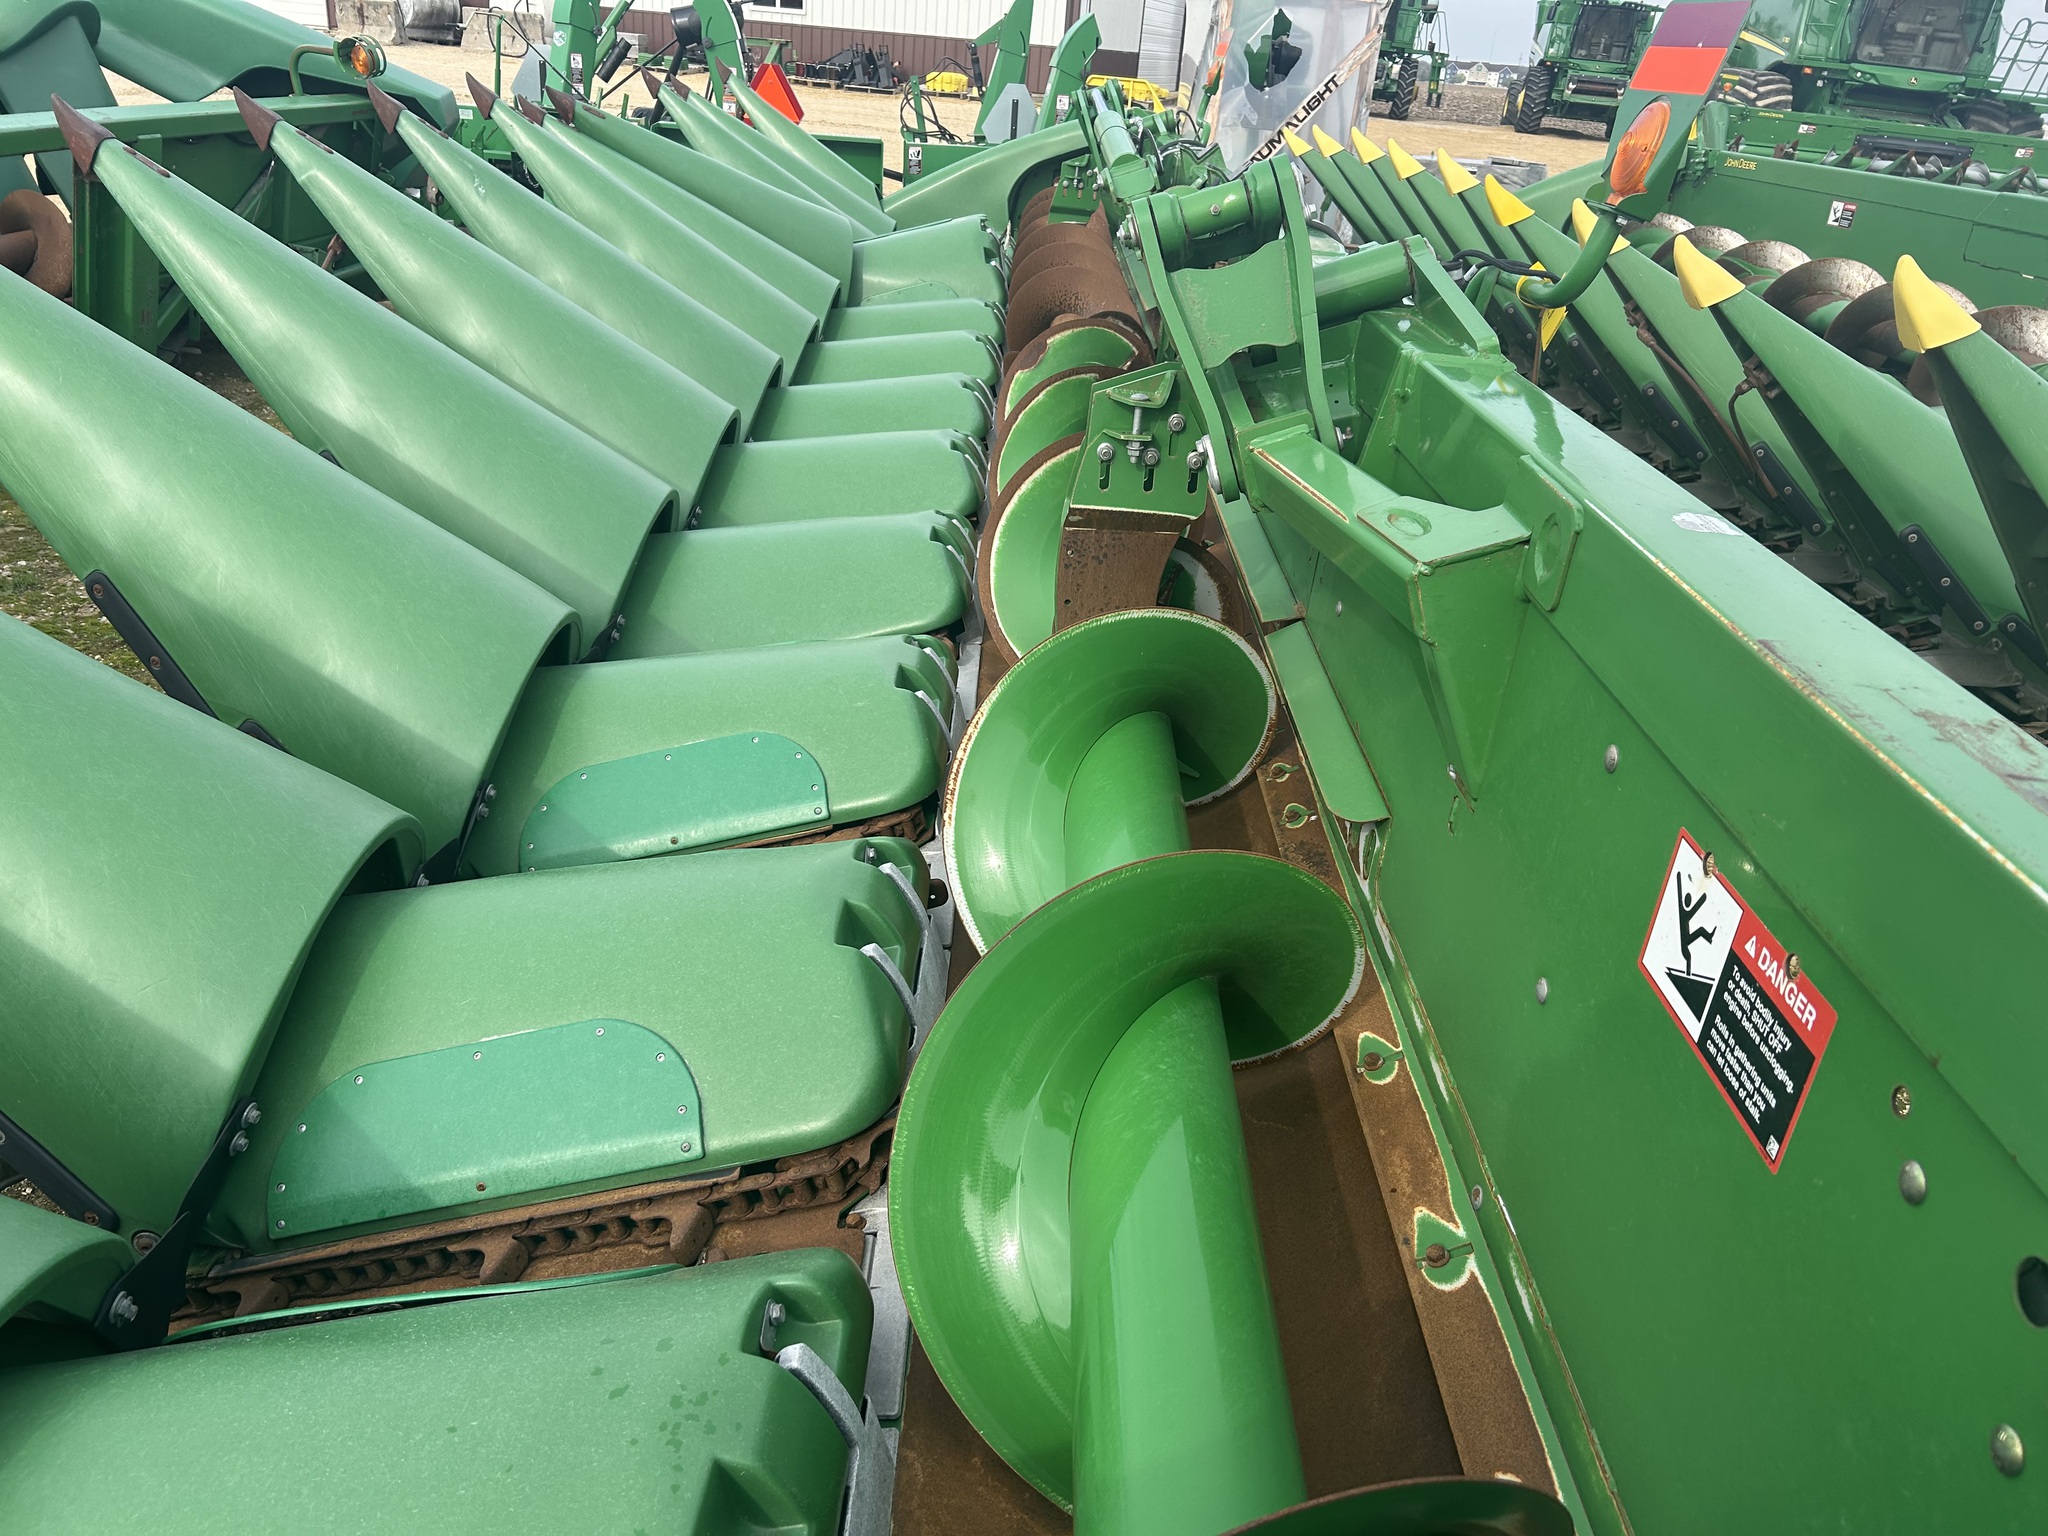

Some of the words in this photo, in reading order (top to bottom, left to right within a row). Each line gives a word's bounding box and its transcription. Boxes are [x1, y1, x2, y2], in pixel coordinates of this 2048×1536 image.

[1727, 979, 1735, 991] or
[1733, 988, 1750, 1017] death,
[1751, 1009, 1770, 1037] SHUT
[1767, 1032, 1783, 1053] OFF
[1732, 964, 1740, 981] To
[1739, 977, 1757, 1002] avoid
[1754, 995, 1774, 1027] bodily
[1772, 1020, 1792, 1051] injury
[1757, 946, 1817, 1031] DANGER
[1706, 1039, 1717, 1057] can
[1715, 1051, 1725, 1068] let
[1723, 1062, 1739, 1090] loose
[1738, 1087, 1747, 1100] of
[1744, 1097, 1760, 1124] stalk.
[1710, 1027, 1725, 1052] move
[1724, 1046, 1741, 1074] faster
[1740, 1070, 1754, 1094] than
[1751, 1090, 1765, 1111] you
[1714, 1014, 1729, 1039] Rolls
[1727, 1033, 1735, 1048] in
[1733, 1044, 1761, 1088] gathering
[1759, 1082, 1776, 1108] units
[1723, 991, 1742, 1019] engine
[1740, 1013, 1760, 1044] before
[1759, 1041, 1793, 1093] unclogging.
